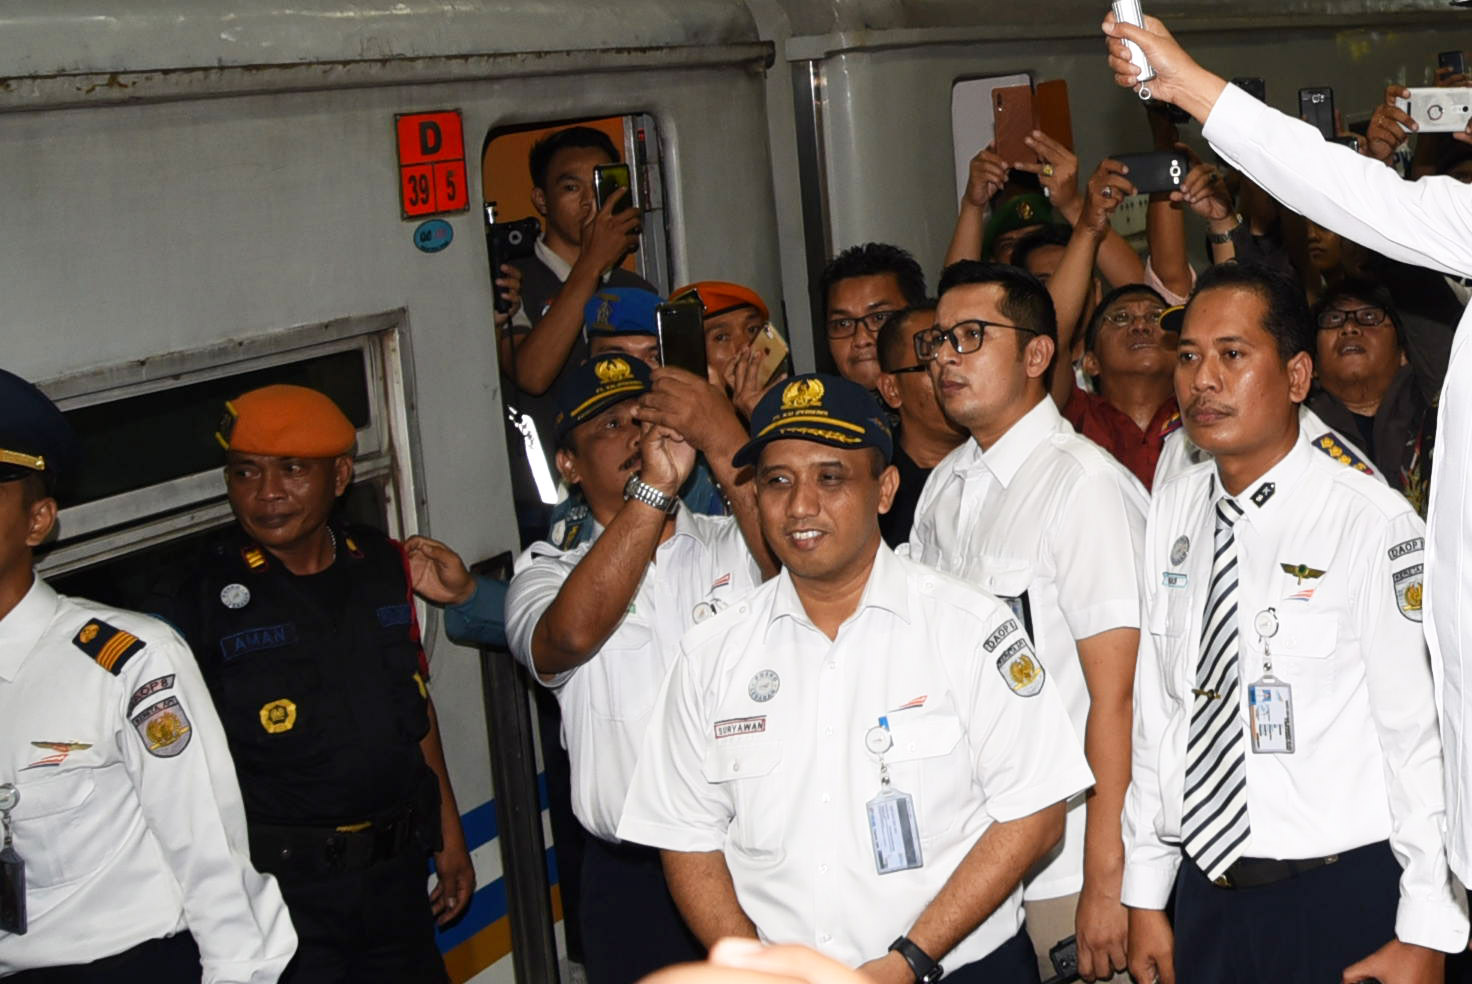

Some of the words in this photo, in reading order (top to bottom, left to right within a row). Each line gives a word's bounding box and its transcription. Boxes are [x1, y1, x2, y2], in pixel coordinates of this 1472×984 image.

[419, 120, 443, 156] D
[408, 173, 430, 207] 39
[445, 170, 457, 202] 5
[718, 721, 763, 736] SURYAWAN
